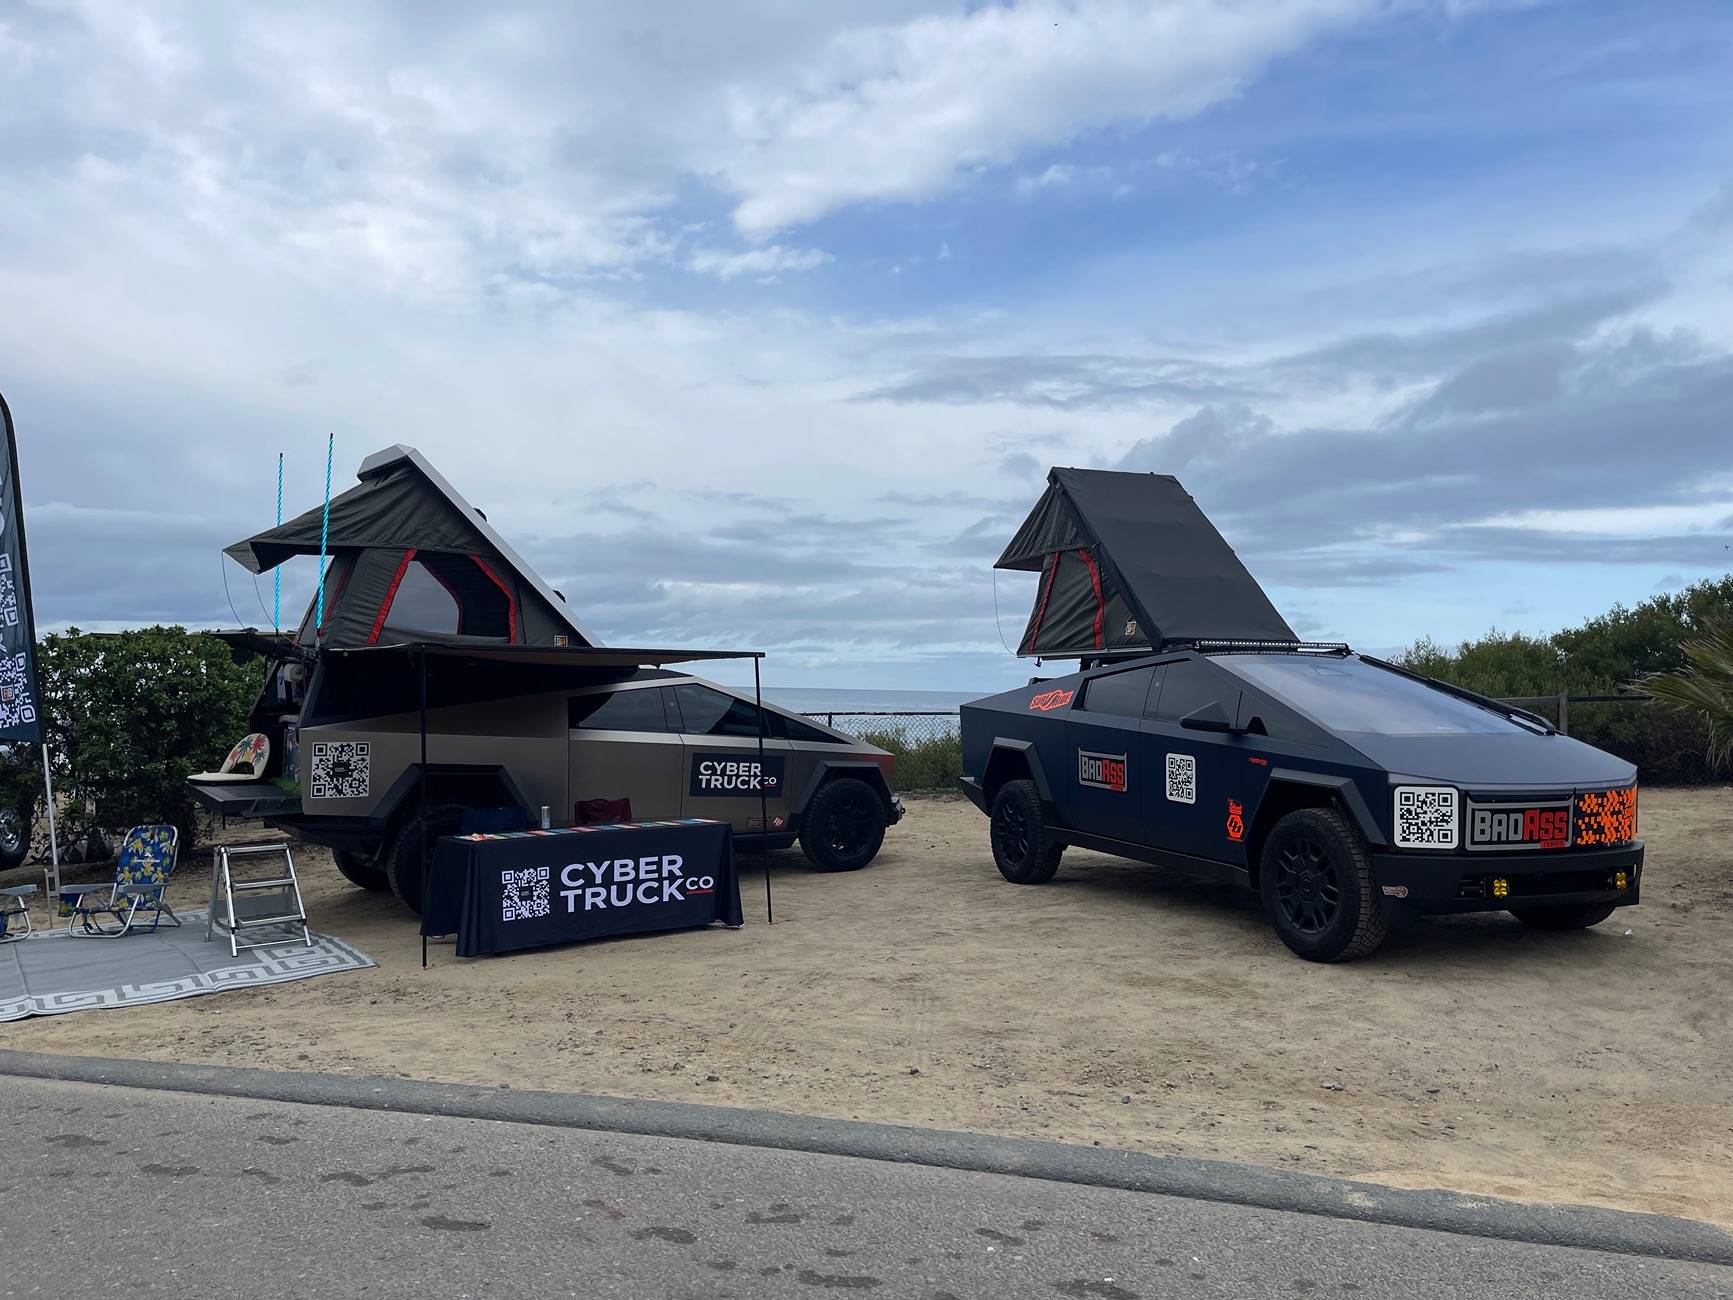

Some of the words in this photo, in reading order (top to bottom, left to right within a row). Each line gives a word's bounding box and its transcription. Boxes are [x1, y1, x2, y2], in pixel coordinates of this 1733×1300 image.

[699, 761, 762, 775] CYBER
[698, 775, 762, 789] TRUCK
[560, 855, 683, 887] CYBER
[560, 878, 685, 913] TRUCK
[686, 876, 714, 890] CO
